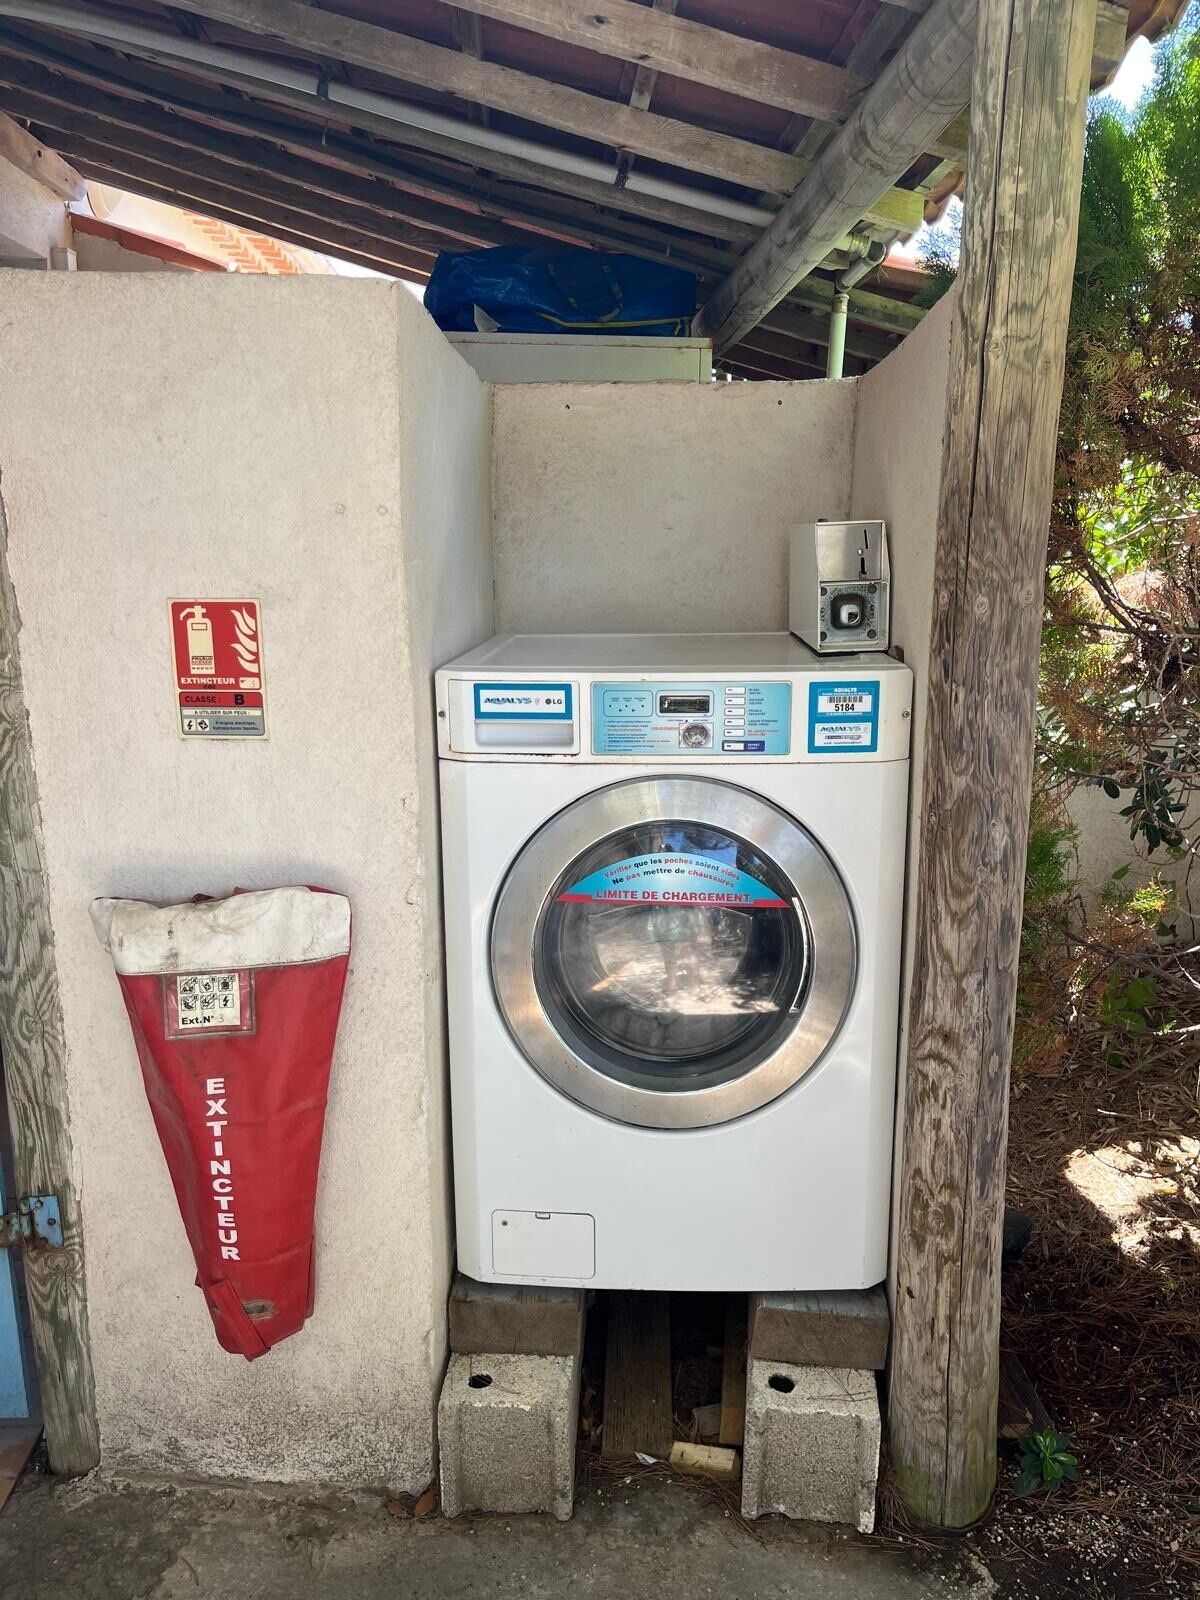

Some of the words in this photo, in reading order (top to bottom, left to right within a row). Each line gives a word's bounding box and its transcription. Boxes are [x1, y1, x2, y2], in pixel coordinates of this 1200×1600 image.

[180, 677, 236, 685] EXTINCTEUR
[234, 693, 245, 706] B
[834, 703, 855, 712] 5184
[695, 860, 720, 872] soient
[721, 868, 740, 880] vides
[612, 877, 624, 885] Ne
[626, 872, 641, 881] pas
[643, 867, 673, 876] mettre
[688, 869, 735, 888] chaussures
[596, 890, 638, 899] LIMITE
[642, 891, 659, 900] DE
[662, 891, 750, 902] CHARGEMENT
[206, 1078, 241, 1261] EXTINCTEUR
